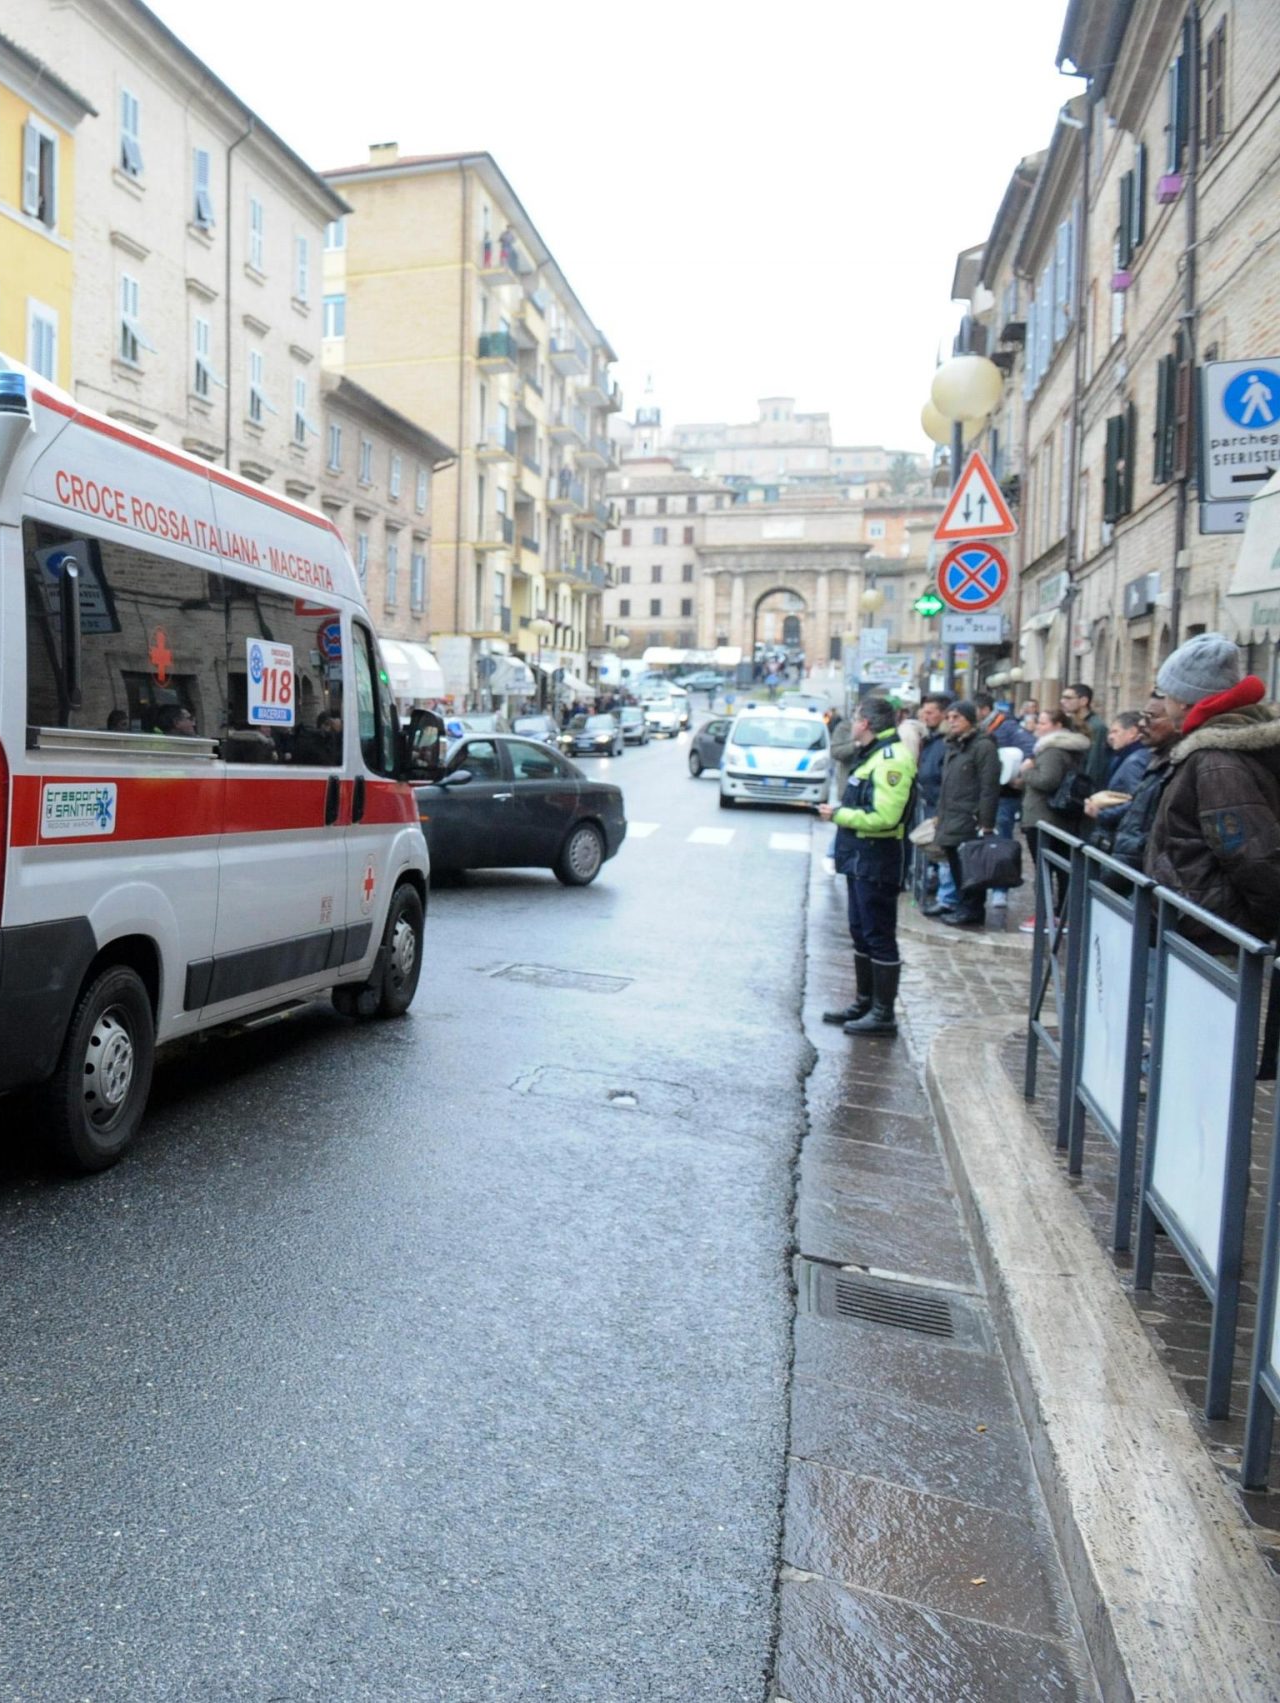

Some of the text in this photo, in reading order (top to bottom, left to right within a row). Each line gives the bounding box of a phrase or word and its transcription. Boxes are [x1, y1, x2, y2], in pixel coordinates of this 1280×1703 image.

[55, 470, 128, 523] CROCE
[131, 496, 192, 545] ROSSA
[194, 519, 261, 567] ITALIANA
[268, 546, 334, 592] MACERATA
[262, 667, 292, 704] 118
